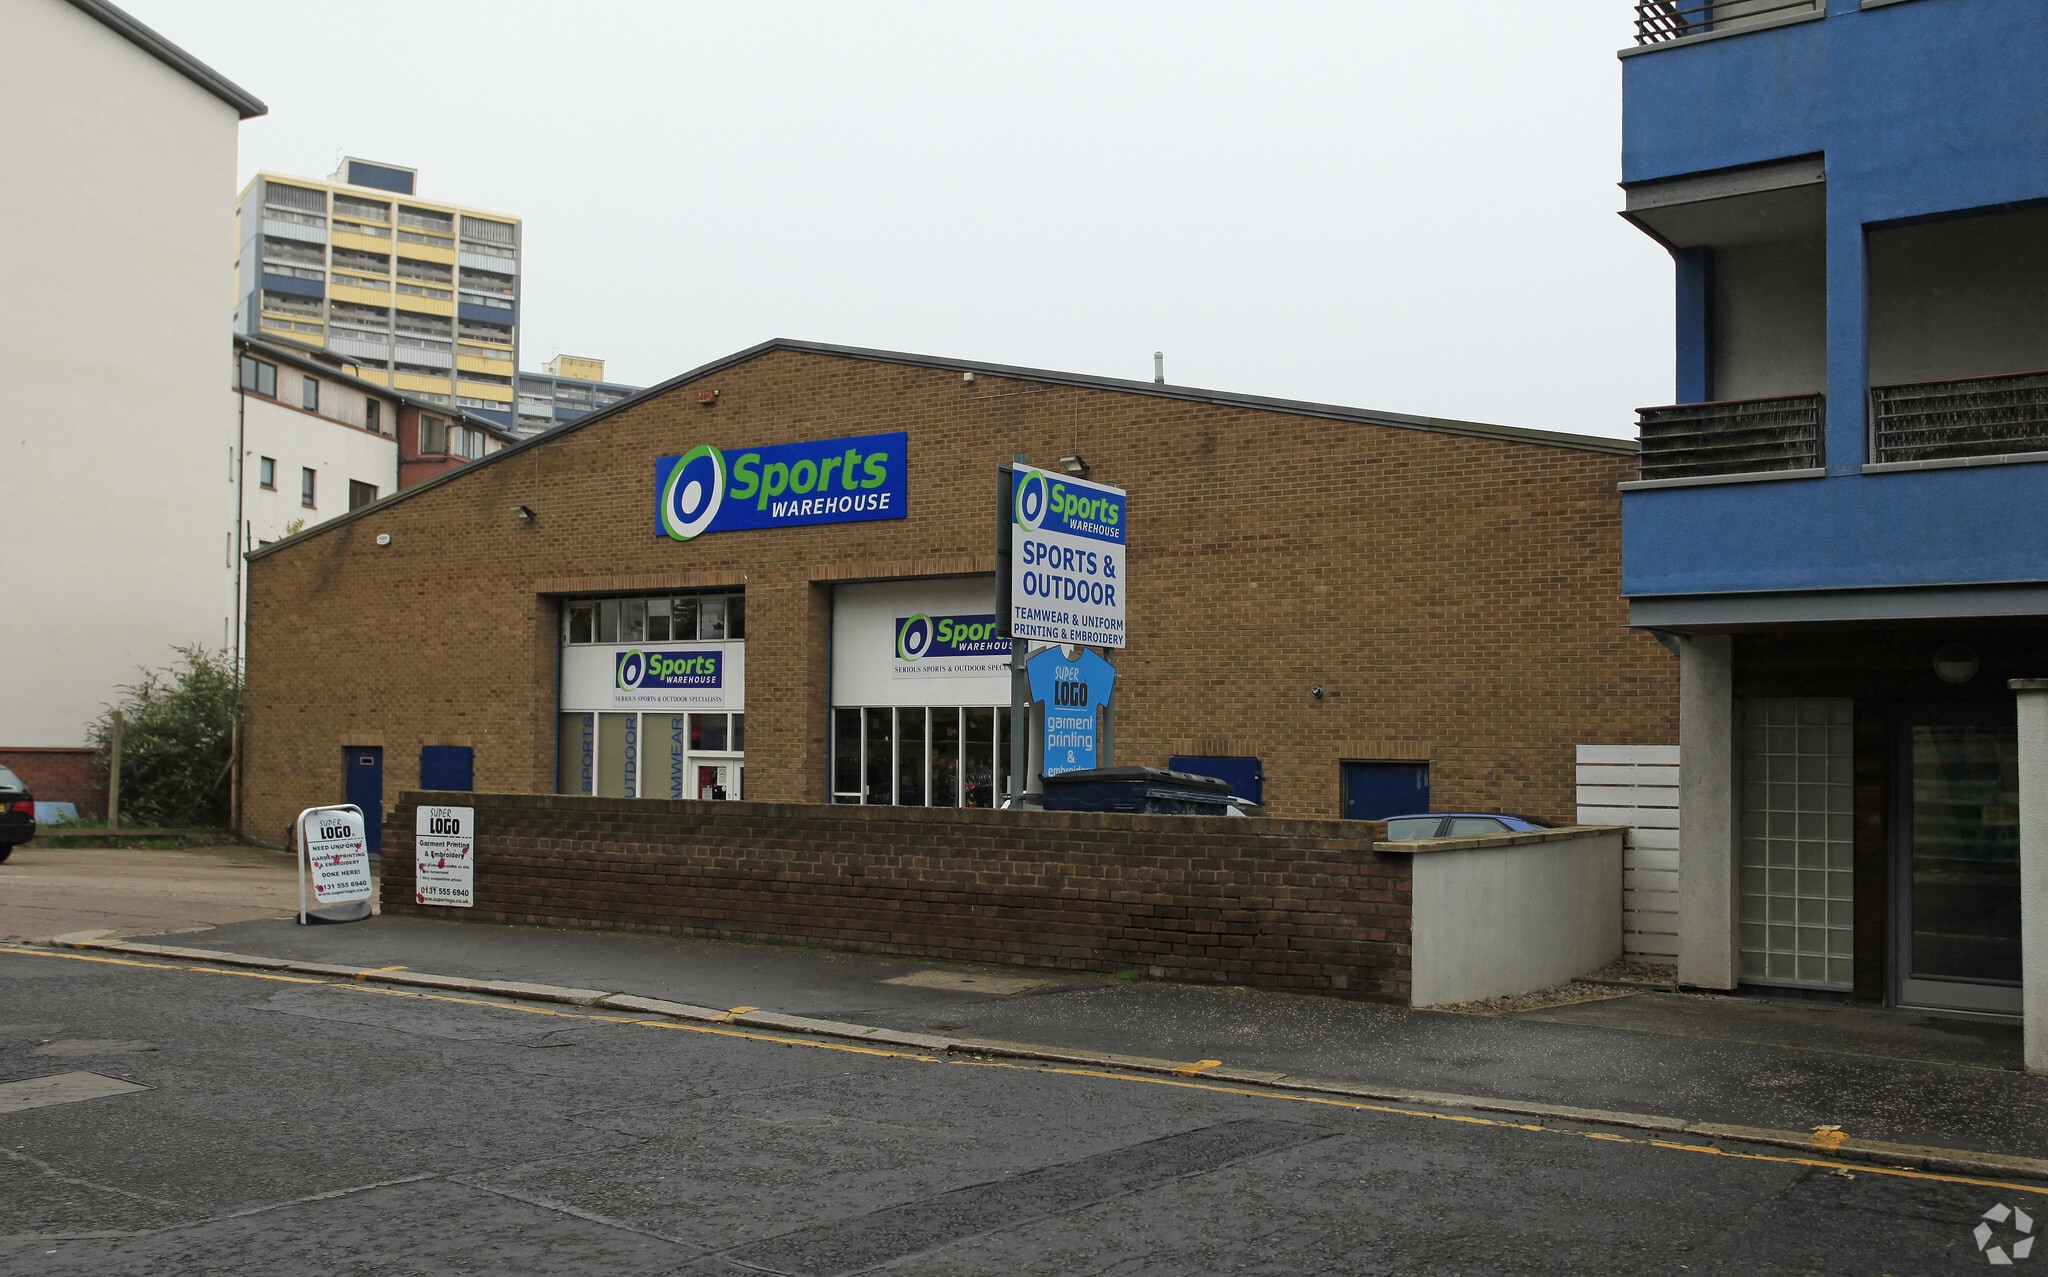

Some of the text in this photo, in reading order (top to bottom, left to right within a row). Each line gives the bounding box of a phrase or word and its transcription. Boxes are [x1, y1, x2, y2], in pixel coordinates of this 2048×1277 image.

[730, 448, 888, 511] Sports
[772, 492, 891, 518] WAREHOUSE
[1050, 483, 1119, 525] Sports
[1070, 518, 1120, 538] WAREHOUSE
[1022, 540, 1117, 579] SPORTS &
[1022, 571, 1117, 607] OUTDOOR
[1014, 606, 1123, 631] TEAMWEAR & UNIFORM
[936, 618, 1011, 648] Spor
[1014, 623, 1123, 645] PRINTING & EMBROIDERY
[959, 641, 1013, 651] WAREHOUS
[648, 653, 716, 681] Sports
[923, 665, 946, 673] SPORTS
[954, 664, 986, 672] OUTDOOR
[1054, 665, 1080, 682] SUPER
[666, 676, 717, 684] WAREHOUSE
[1054, 681, 1088, 707] LOGO
[1047, 715, 1093, 732] garment
[1047, 731, 1093, 751] printing
[581, 715, 594, 792] SPORTS
[624, 717, 637, 798] UTDOOR
[1067, 750, 1076, 763] &
[320, 818, 342, 827] SUPER
[430, 808, 452, 818] SUPER
[320, 826, 351, 839] LOGO
[430, 818, 460, 835] LOGO
[430, 850, 465, 859] Embroidery
[446, 841, 470, 849] Printing
[421, 886, 437, 894] 0131
